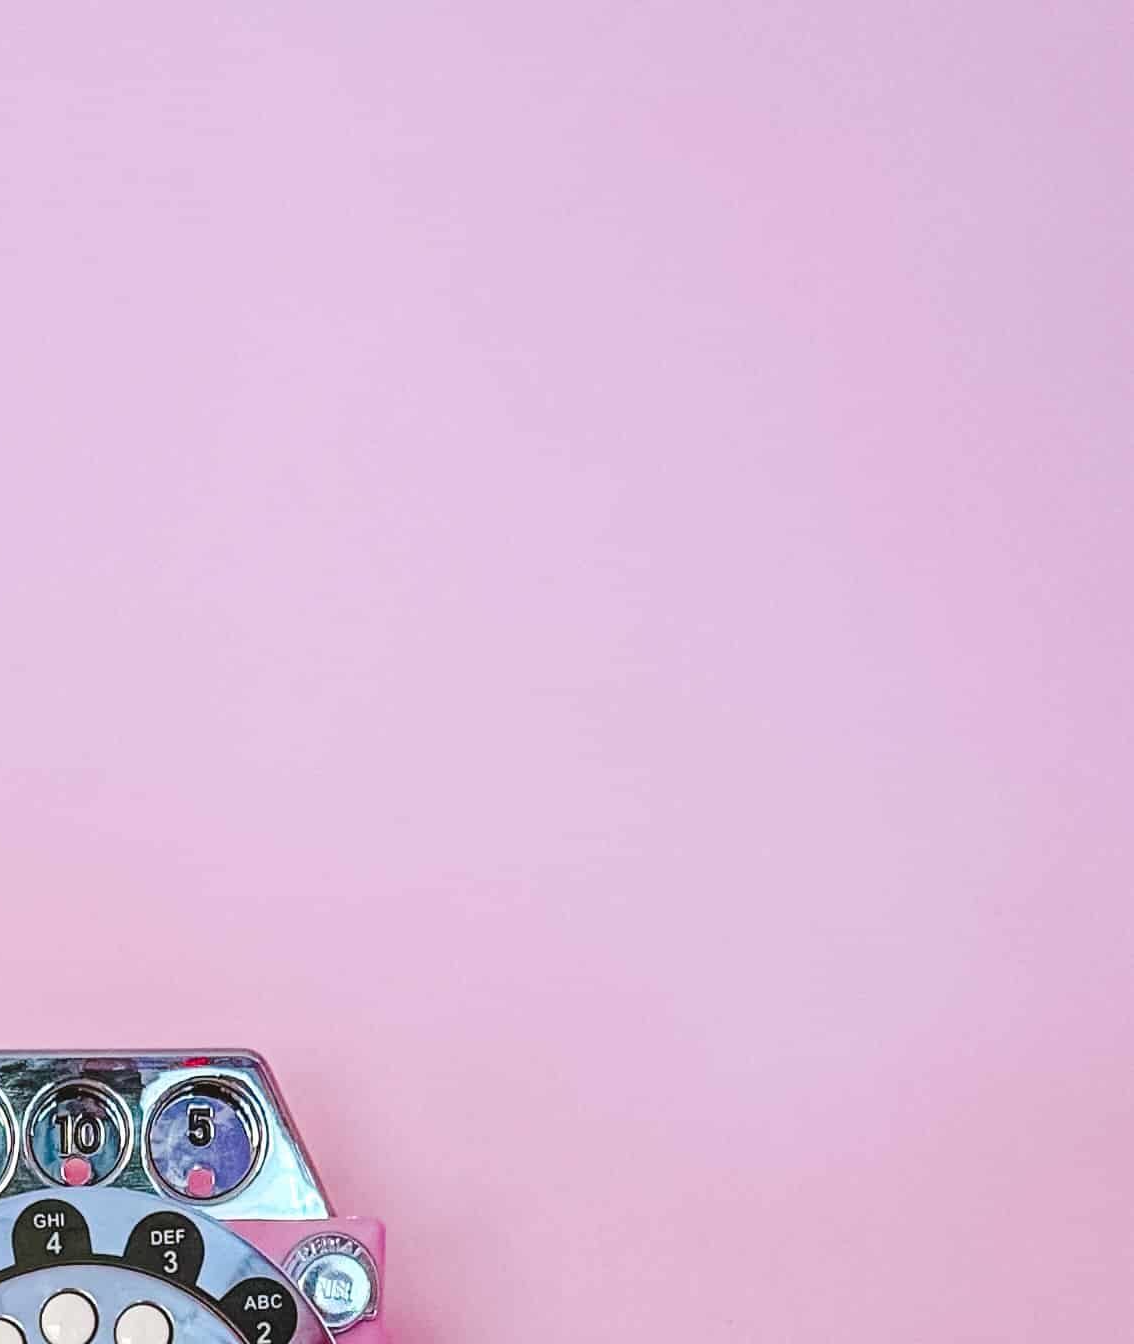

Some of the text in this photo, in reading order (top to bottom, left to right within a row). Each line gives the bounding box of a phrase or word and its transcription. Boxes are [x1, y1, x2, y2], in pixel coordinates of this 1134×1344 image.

[54, 1113, 103, 1156] 10
[186, 1105, 215, 1148] 5
[33, 1213, 65, 1229] GHI
[46, 1231, 62, 1254] 4
[150, 1228, 185, 1246] DEF
[163, 1250, 178, 1274] 3
[244, 1293, 283, 1310] ABC
[256, 1321, 272, 1344] 2
